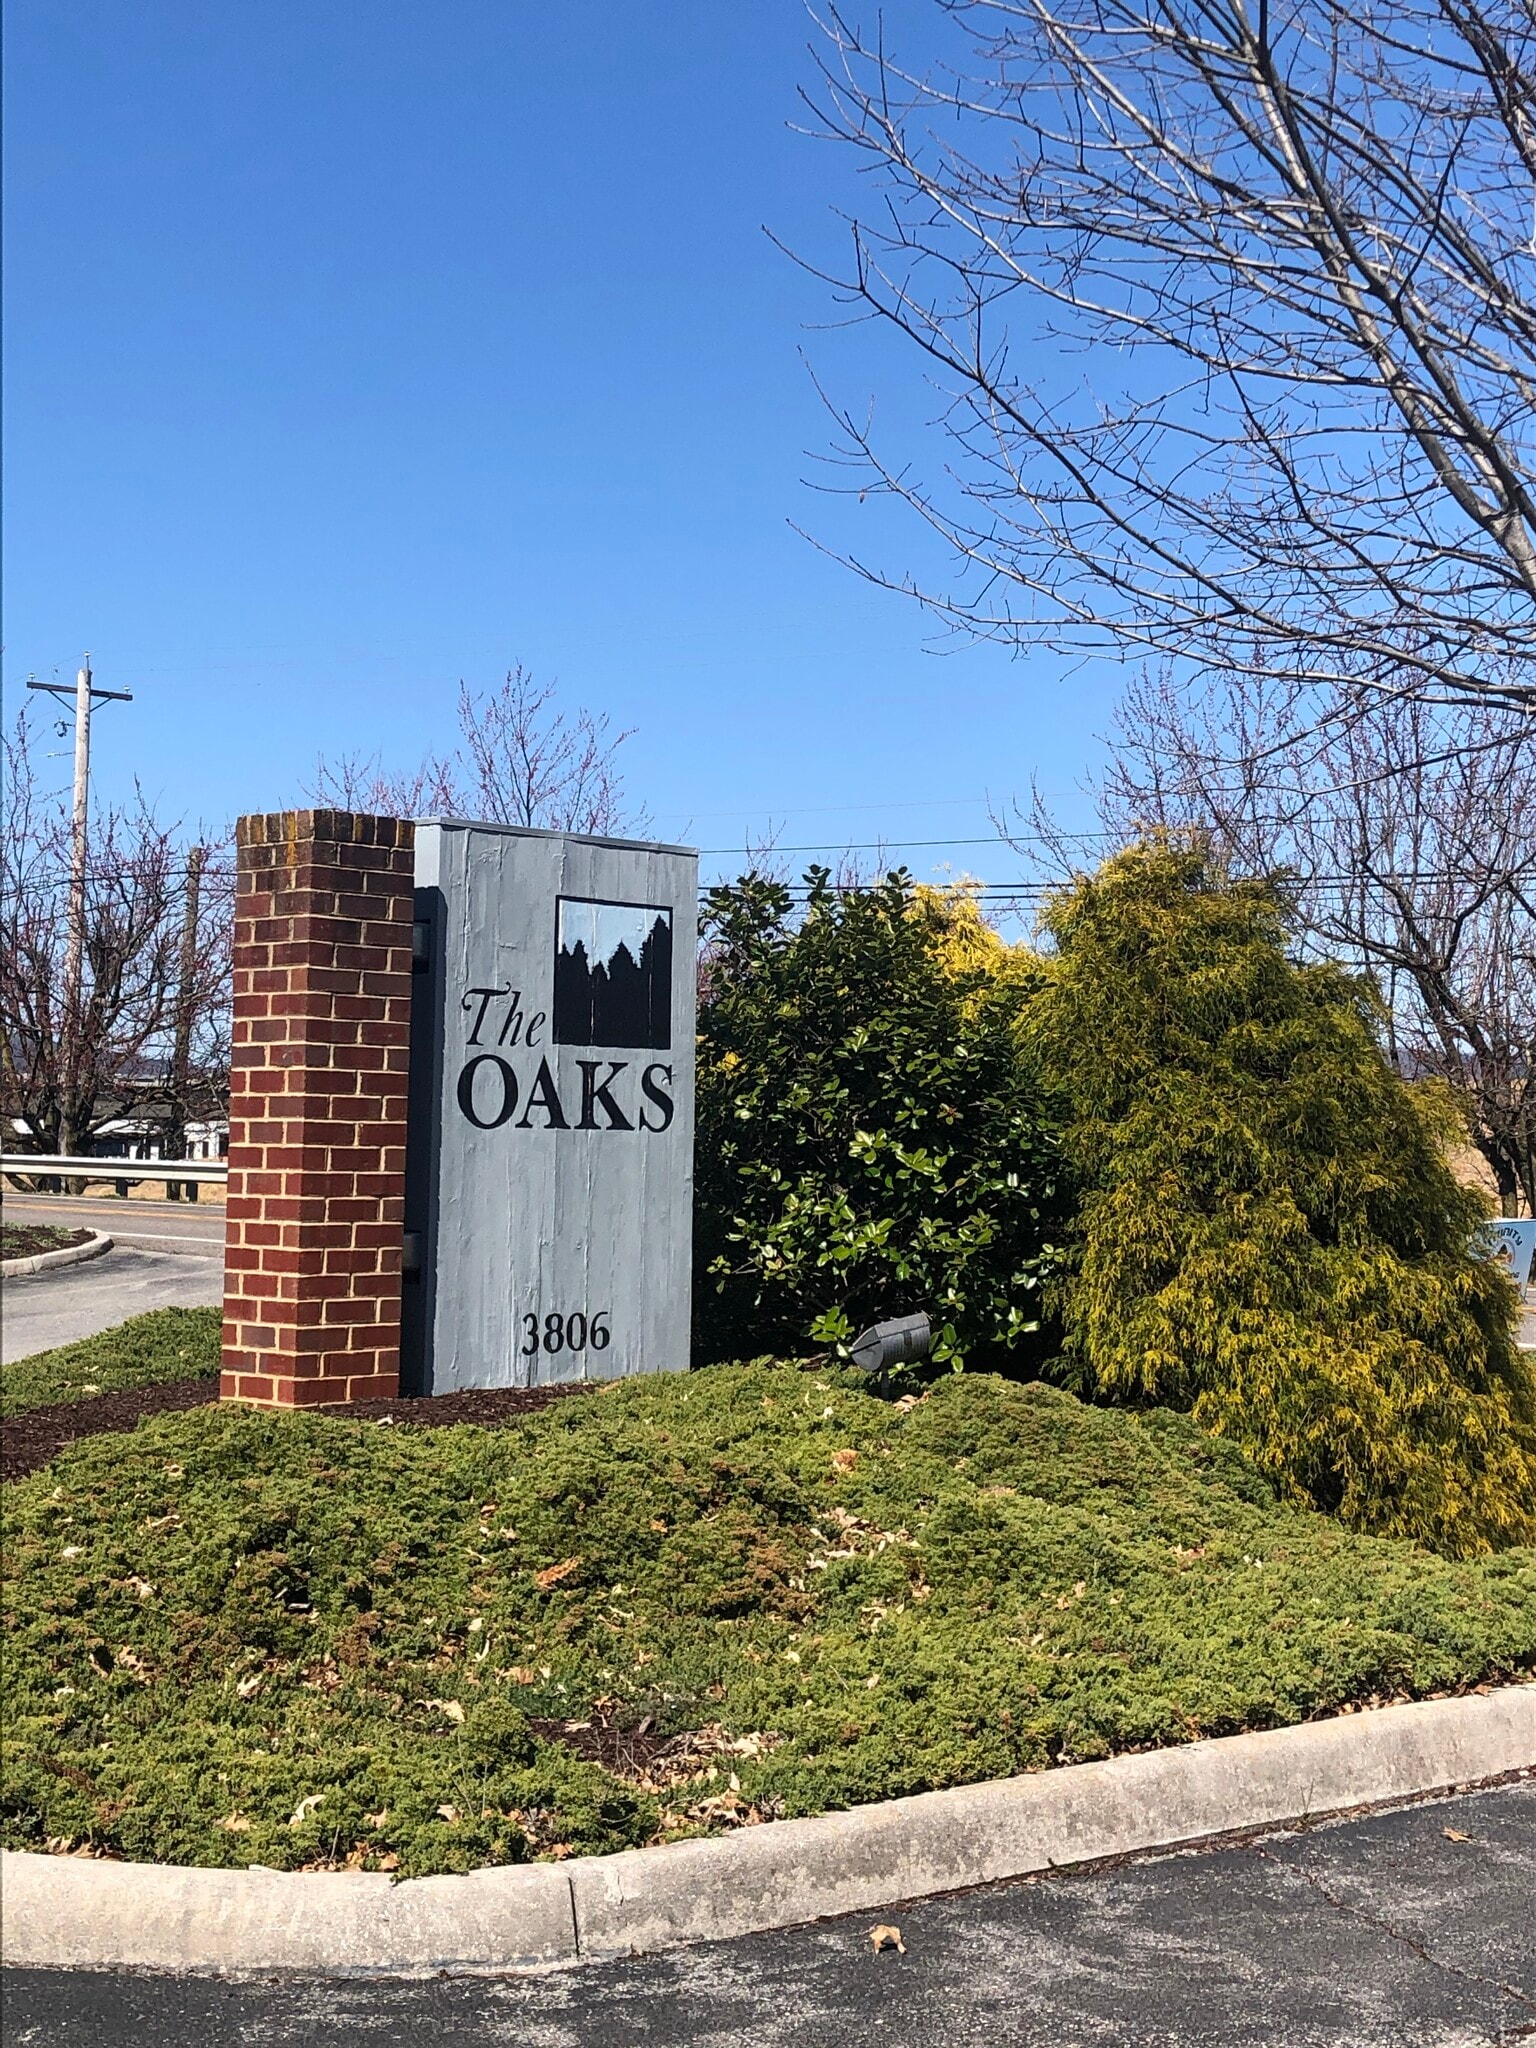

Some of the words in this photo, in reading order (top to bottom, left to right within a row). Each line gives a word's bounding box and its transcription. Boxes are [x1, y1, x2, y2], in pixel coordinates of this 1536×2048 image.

[462, 981, 546, 1047] The
[457, 1053, 674, 1133] OAKS
[521, 1311, 610, 1356] 3806
